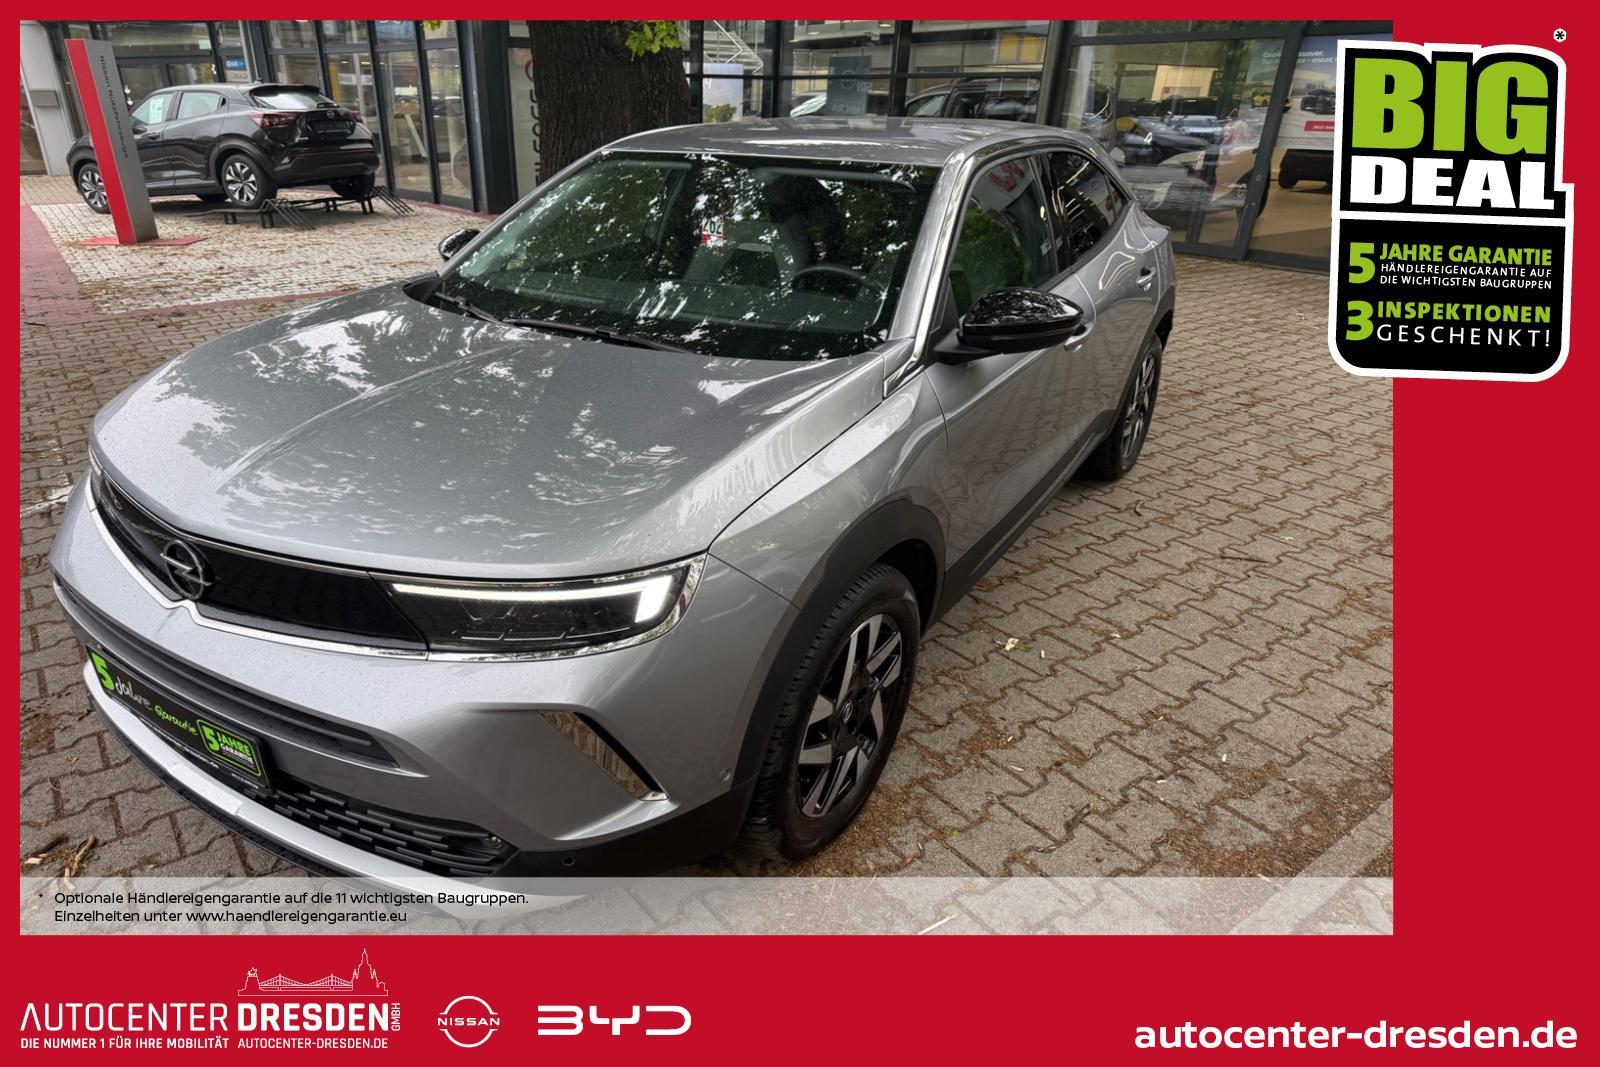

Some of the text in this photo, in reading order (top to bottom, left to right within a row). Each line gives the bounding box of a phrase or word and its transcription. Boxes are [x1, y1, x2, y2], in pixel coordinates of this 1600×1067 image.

[91, 652, 115, 691] 5
[202, 726, 220, 751] 5
[217, 731, 252, 755] JAHRE
